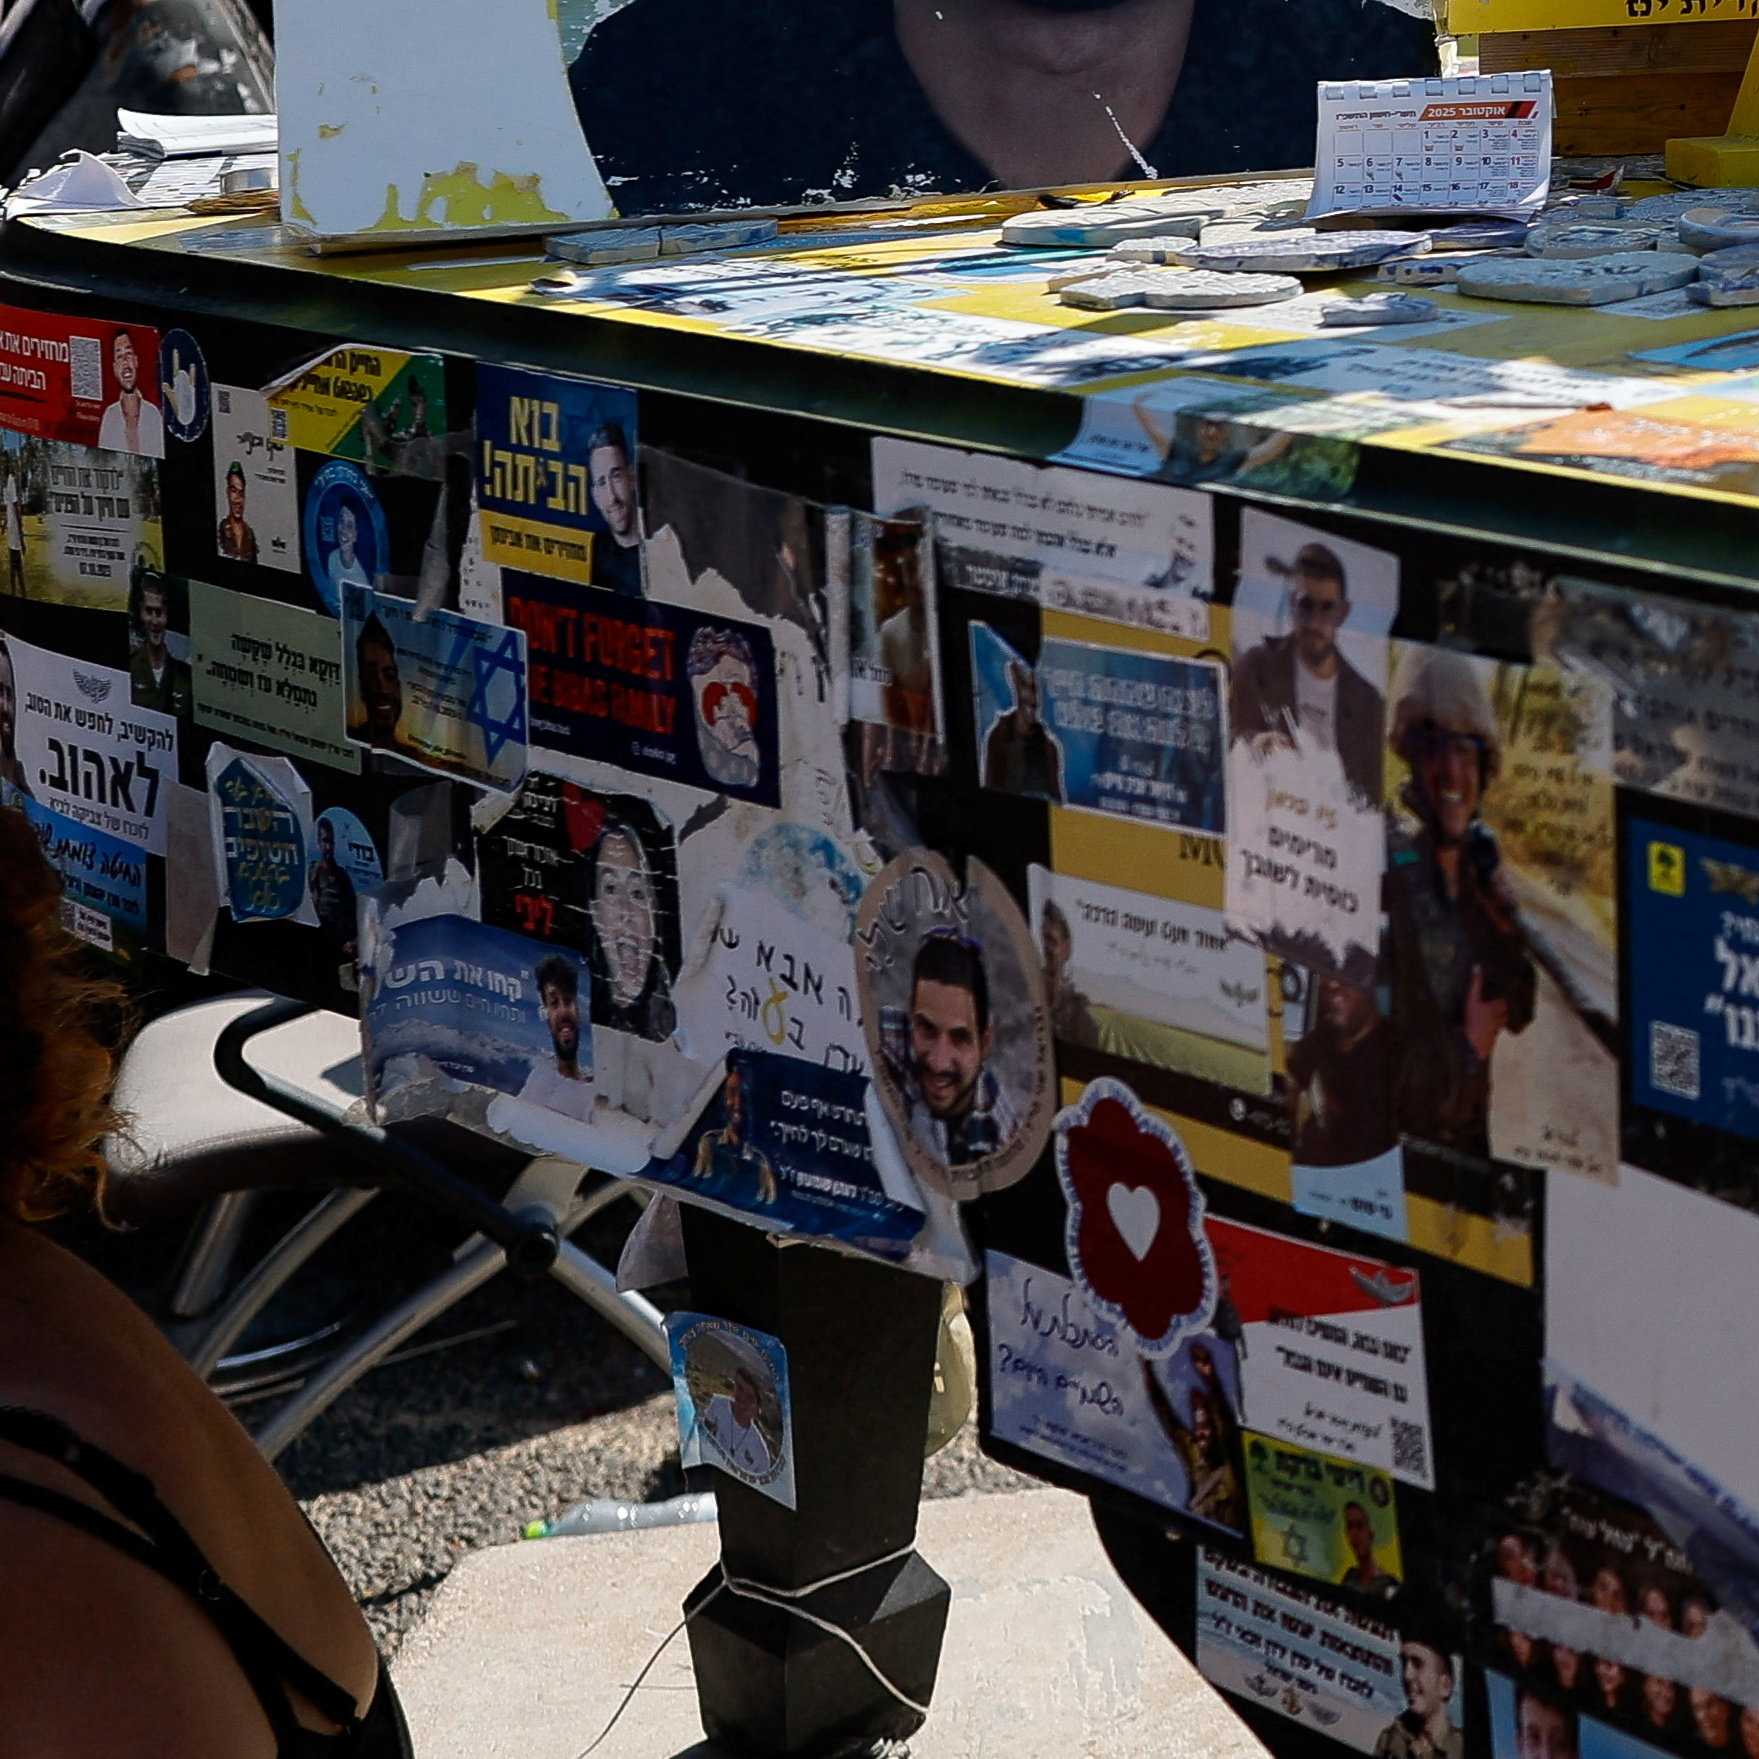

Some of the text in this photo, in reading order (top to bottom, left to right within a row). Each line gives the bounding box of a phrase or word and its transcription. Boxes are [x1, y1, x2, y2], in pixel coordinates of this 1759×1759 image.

[1427, 105, 1507, 118] אוקטובר 2025
[1481, 156, 1492, 167] 10
[1510, 156, 1521, 166] 11
[21, 336, 70, 363] מחזירים
[13, 366, 47, 391] הביתה
[510, 396, 562, 453] בוא
[53, 701, 74, 724] את
[74, 708, 115, 736] לחפש
[117, 720, 175, 753] להקשיב,
[39, 737, 161, 819] לאהוב.
